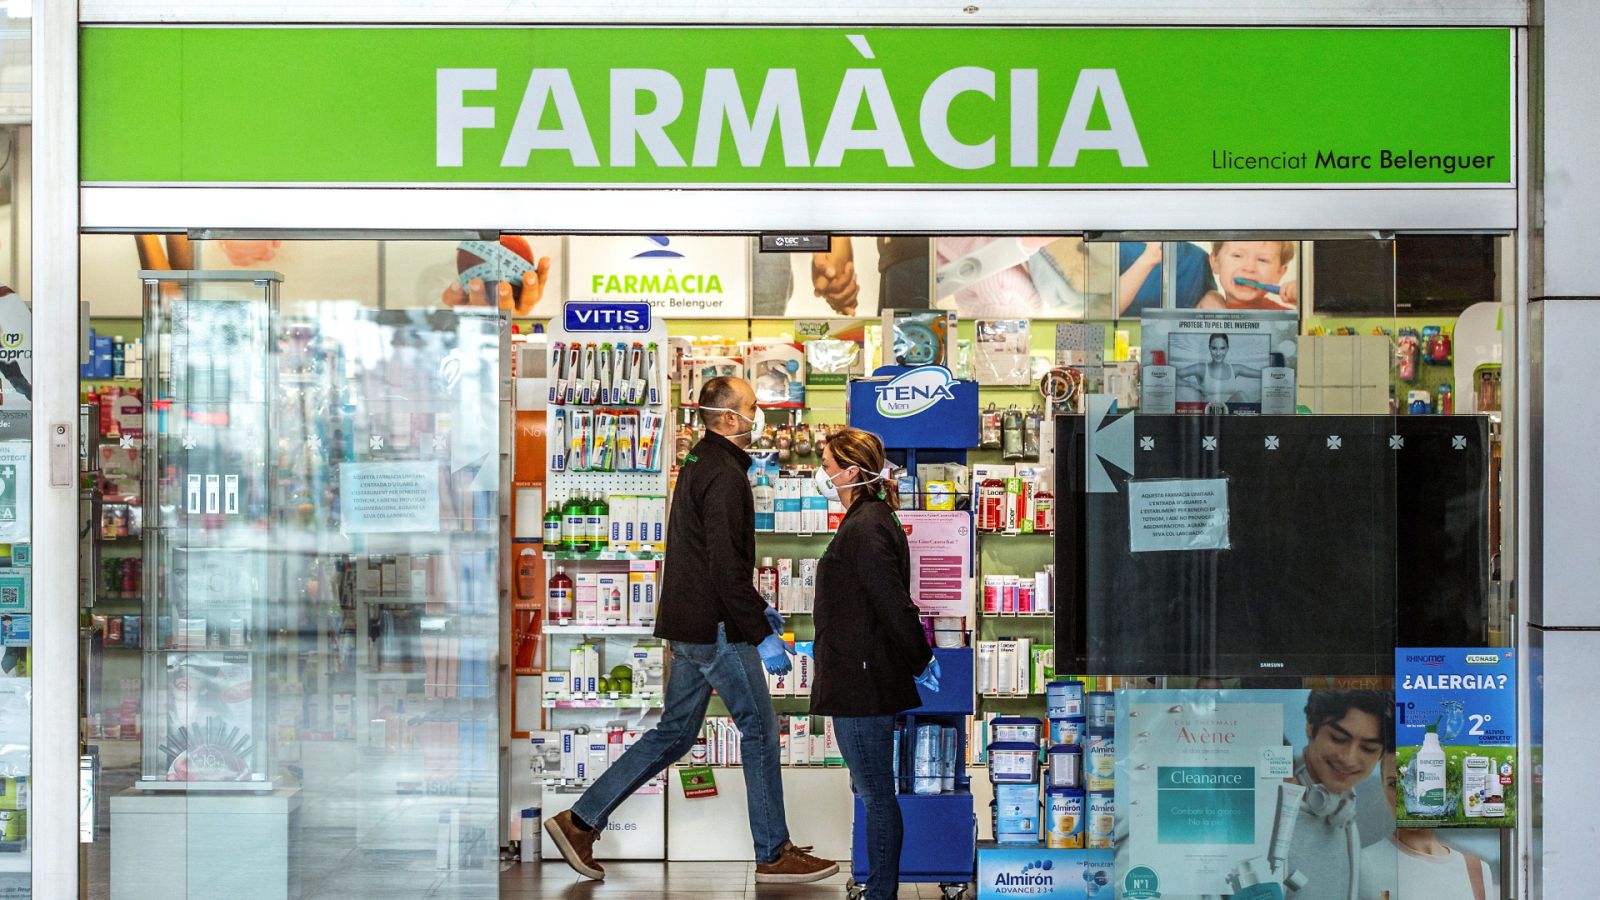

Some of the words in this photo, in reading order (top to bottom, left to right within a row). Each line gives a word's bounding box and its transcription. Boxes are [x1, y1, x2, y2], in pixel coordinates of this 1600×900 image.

[435, 35, 1149, 169] FARMÀCIA
[1212, 150, 1308, 169] Llicenciat
[1315, 150, 1371, 169] Marc
[1380, 150, 1496, 173] Belenguer
[592, 269, 723, 294] FARMÀCIA
[670, 298, 723, 310] Belenguer
[575, 310, 640, 323] VITIS
[875, 384, 951, 401] TENA
[800, 656, 808, 688] Desensin
[1337, 680, 1378, 690] VICHY
[1402, 674, 1508, 690] ¿ALERGIA?
[1175, 726, 1236, 744] Avène
[1170, 770, 1242, 784] Cleanance
[1052, 804, 1080, 812] Almirón
[995, 872, 1052, 886] Almirón
